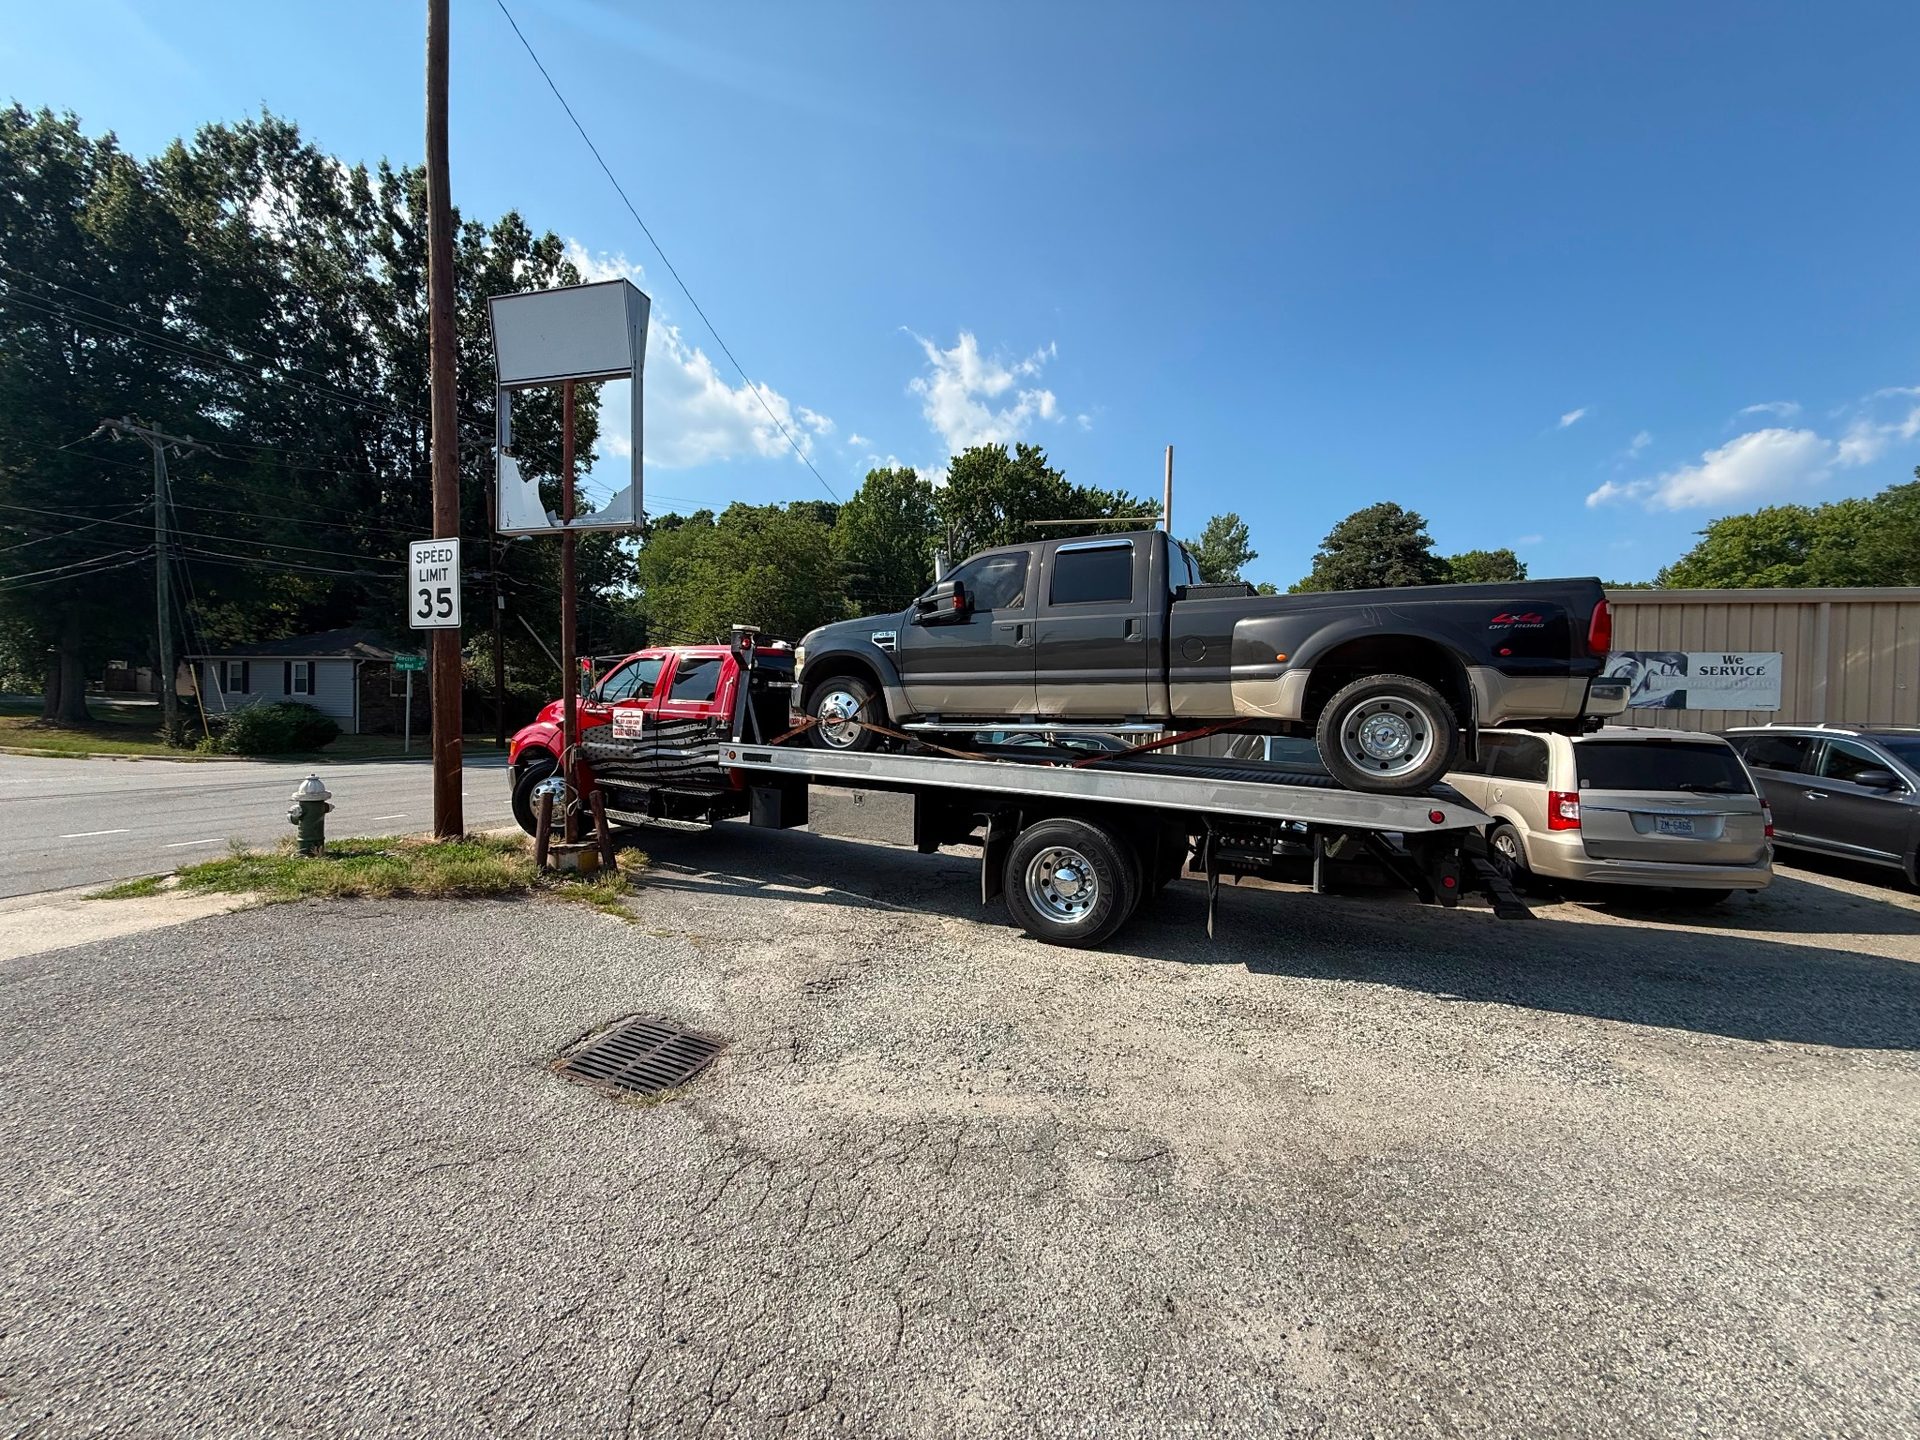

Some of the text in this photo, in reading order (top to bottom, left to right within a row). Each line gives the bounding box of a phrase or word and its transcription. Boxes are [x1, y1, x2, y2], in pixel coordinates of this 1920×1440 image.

[416, 549, 453, 564] SPEED
[419, 568, 448, 582] LIMIT
[417, 588, 453, 619] 35
[1722, 655, 1744, 665] We
[1699, 666, 1766, 676] SERVICE
